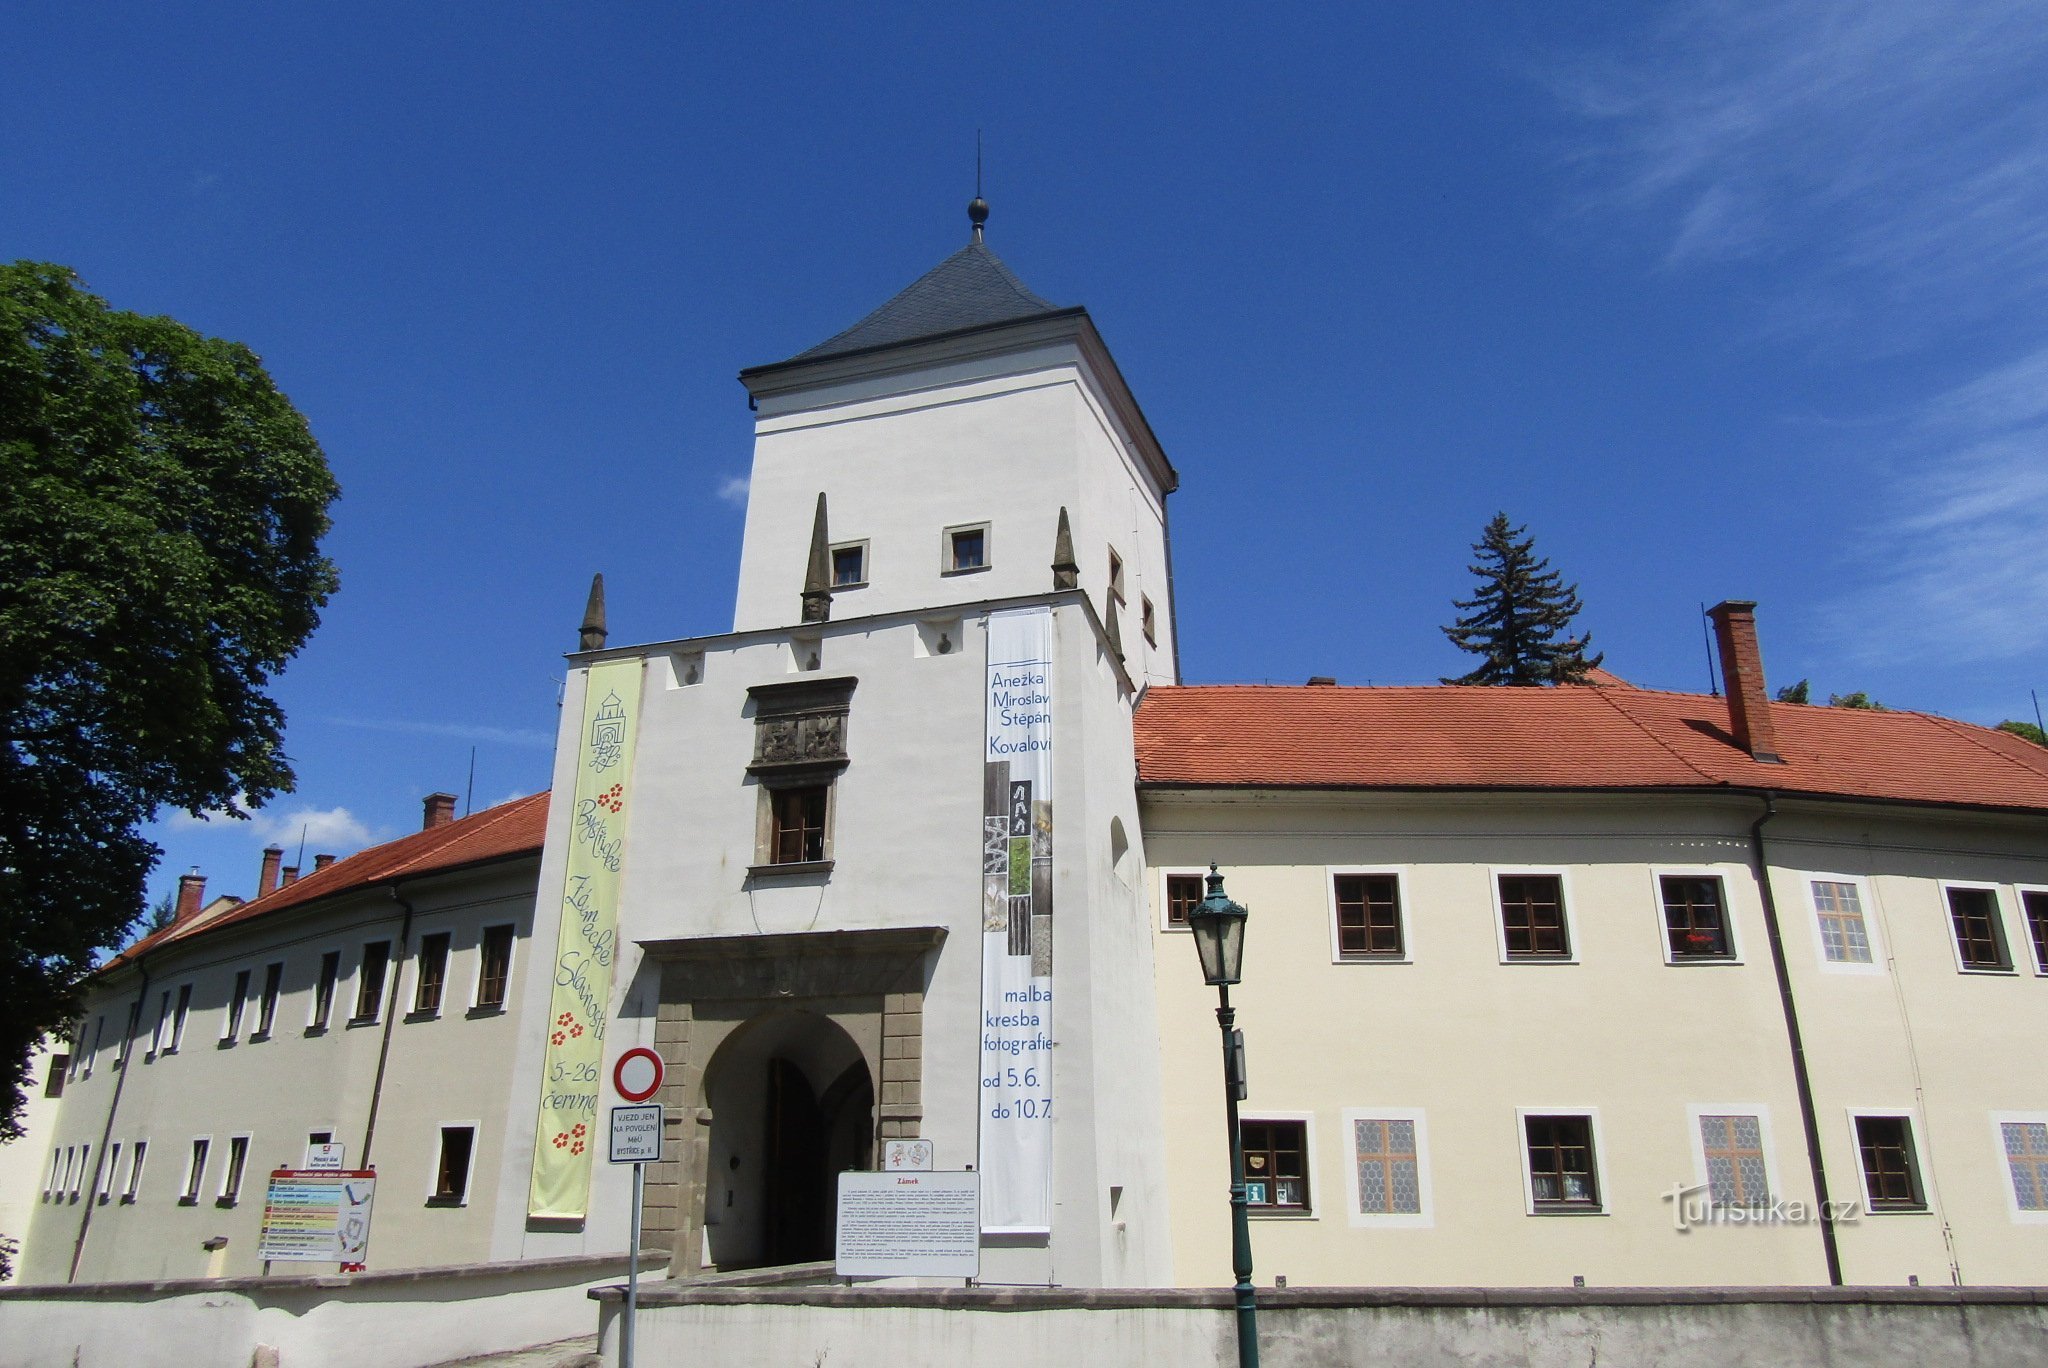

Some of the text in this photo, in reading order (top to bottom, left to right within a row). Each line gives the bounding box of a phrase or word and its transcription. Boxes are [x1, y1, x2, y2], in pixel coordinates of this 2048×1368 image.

[991, 671, 1044, 689] Anežka
[993, 690, 1050, 707] Miroslav
[1001, 706, 1051, 729] Štěpán
[990, 734, 1051, 754] Kovalovi
[556, 951, 606, 1041] Slavnosti
[1005, 985, 1052, 1002] malba
[986, 1009, 1040, 1027] kresba
[984, 1032, 1052, 1055] fotografie
[983, 1071, 1001, 1088] od
[617, 1113, 655, 1122] VJEZD JEN
[991, 1102, 1010, 1118] do
[625, 1122, 658, 1133] POVOLENÍ
[897, 1177, 919, 1185] Zámek
